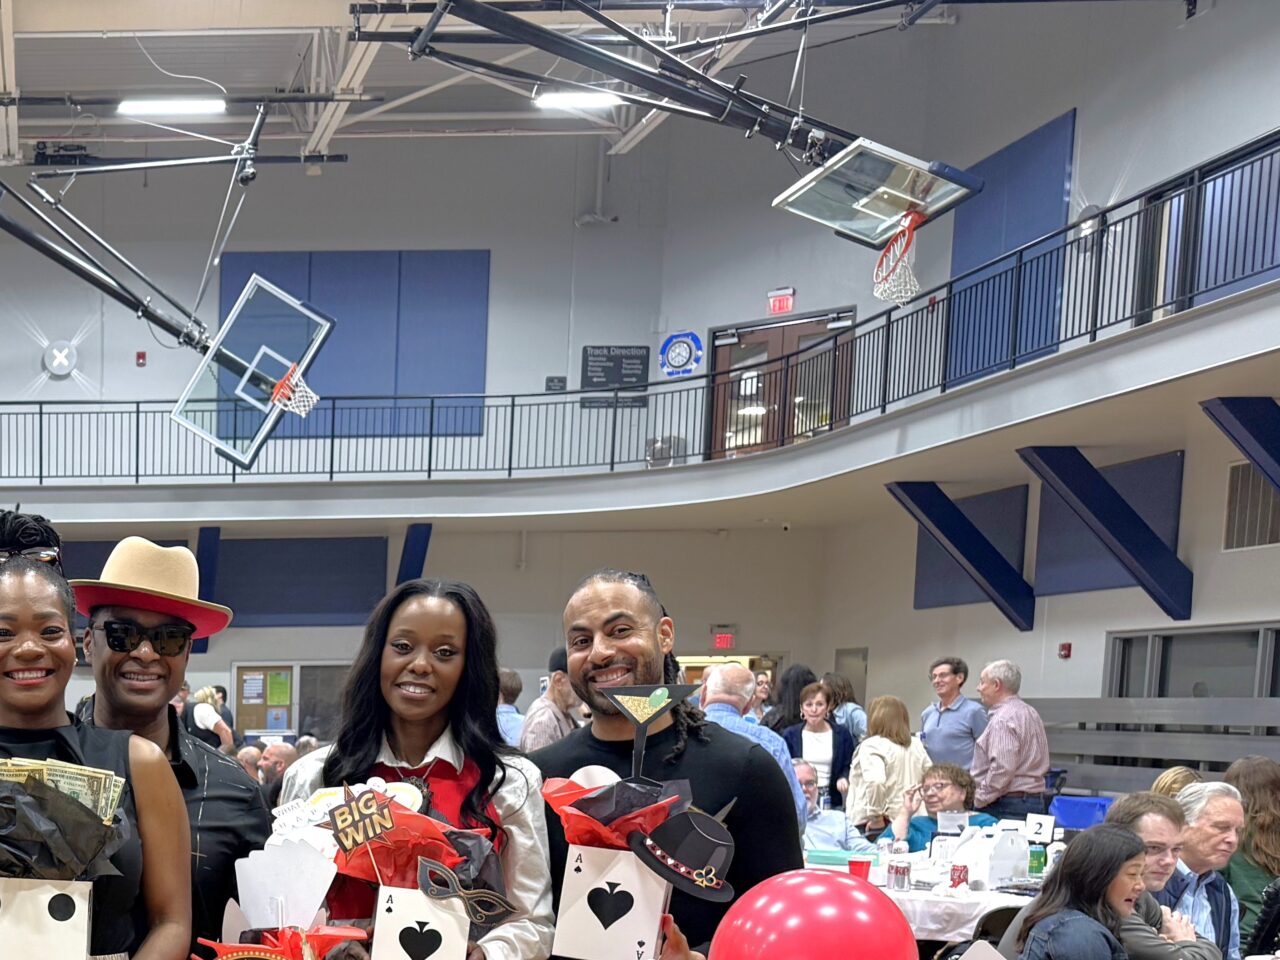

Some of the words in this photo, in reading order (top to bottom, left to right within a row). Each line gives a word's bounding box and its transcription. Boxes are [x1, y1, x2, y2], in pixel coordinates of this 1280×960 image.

[610, 347, 646, 356] Direction
[334, 792, 378, 830] BIG
[338, 808, 393, 851] WIN
[1033, 822, 1043, 835] 2
[575, 853, 583, 863] A
[386, 894, 394, 904] A
[636, 950, 644, 960] A
